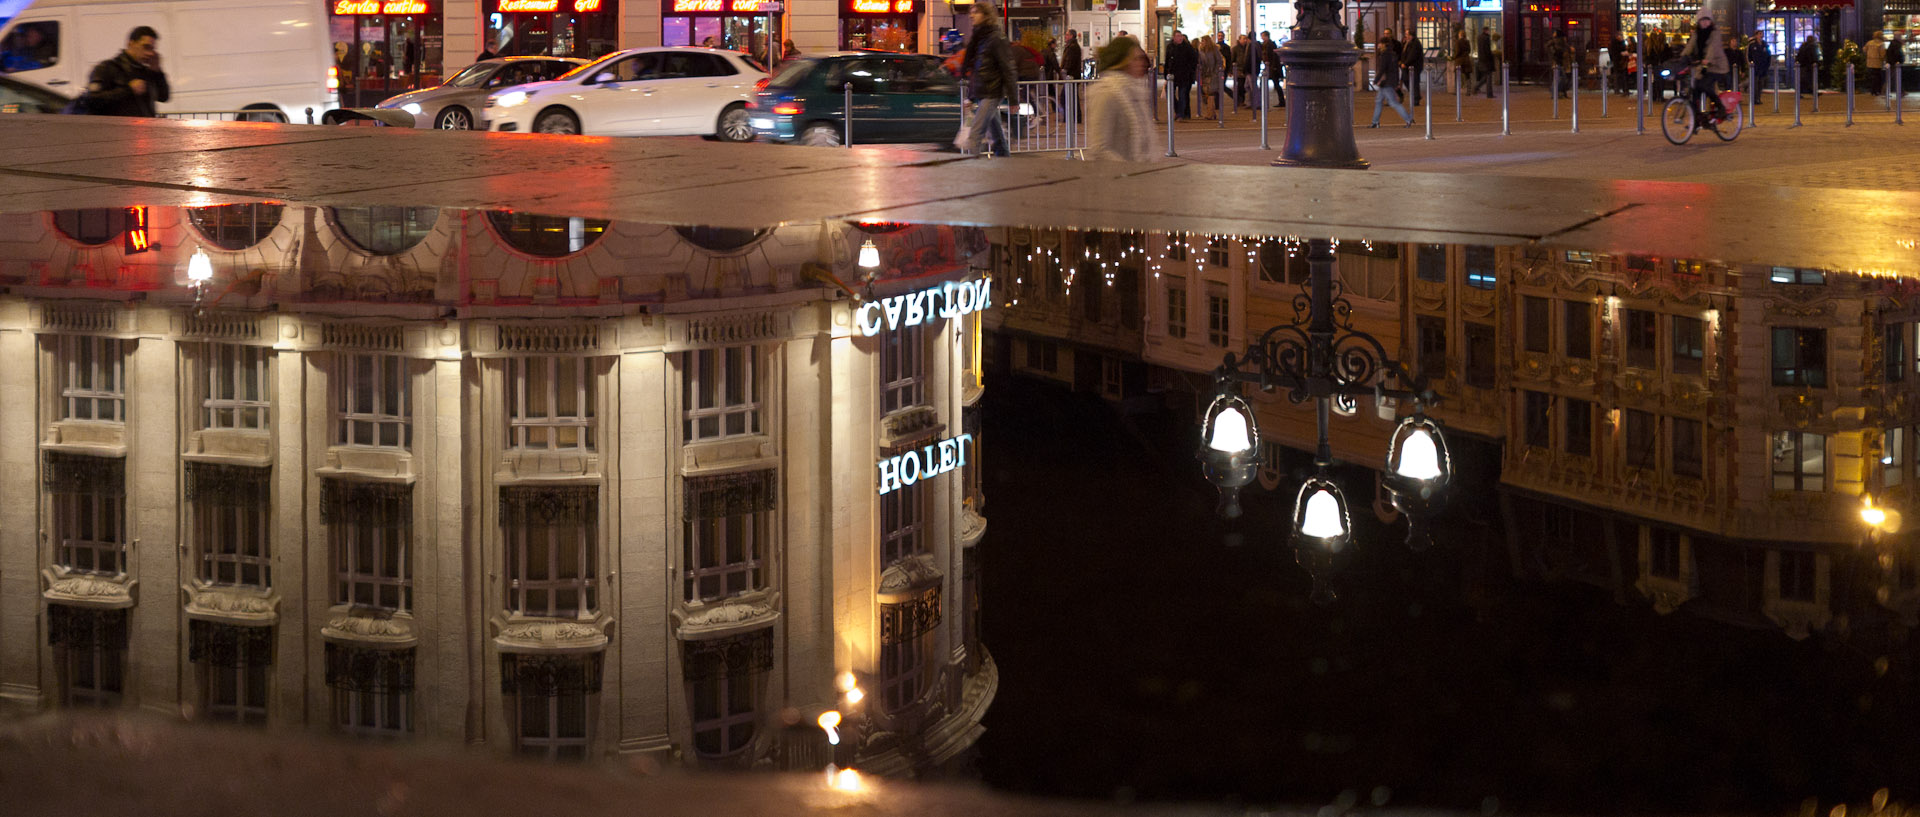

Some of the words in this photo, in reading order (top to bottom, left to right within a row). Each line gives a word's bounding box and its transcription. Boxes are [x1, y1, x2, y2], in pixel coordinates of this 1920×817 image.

[335, 0, 379, 14] Service
[383, 0, 426, 14] continu
[574, 0, 600, 12] Grill
[674, 0, 722, 11] Service
